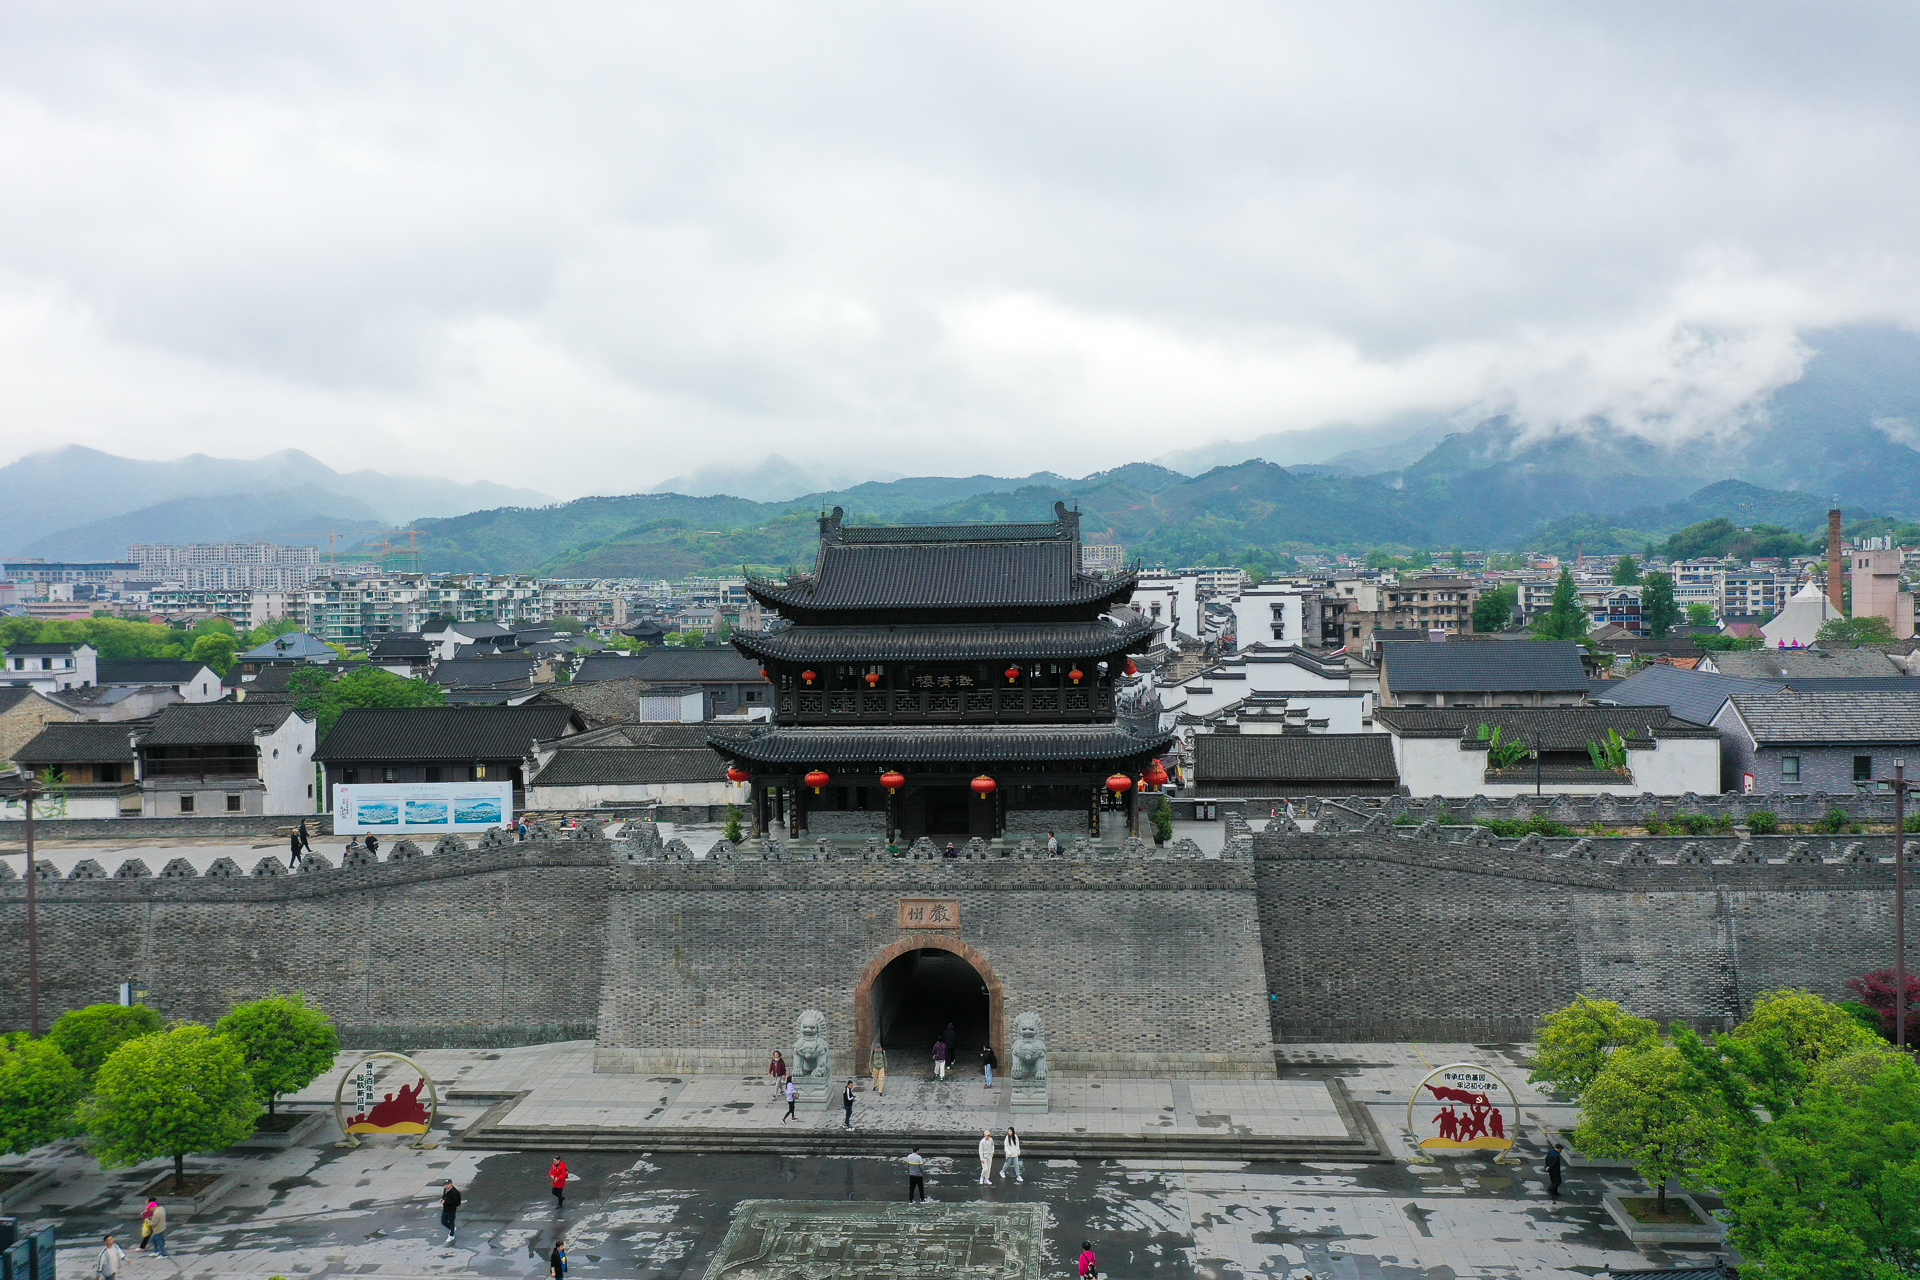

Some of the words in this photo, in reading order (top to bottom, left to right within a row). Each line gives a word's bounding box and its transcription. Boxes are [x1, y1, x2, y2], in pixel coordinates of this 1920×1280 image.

[1444, 1072, 1486, 1081] 传承红色基因
[1456, 1081, 1498, 1090] 牢记初心使命
